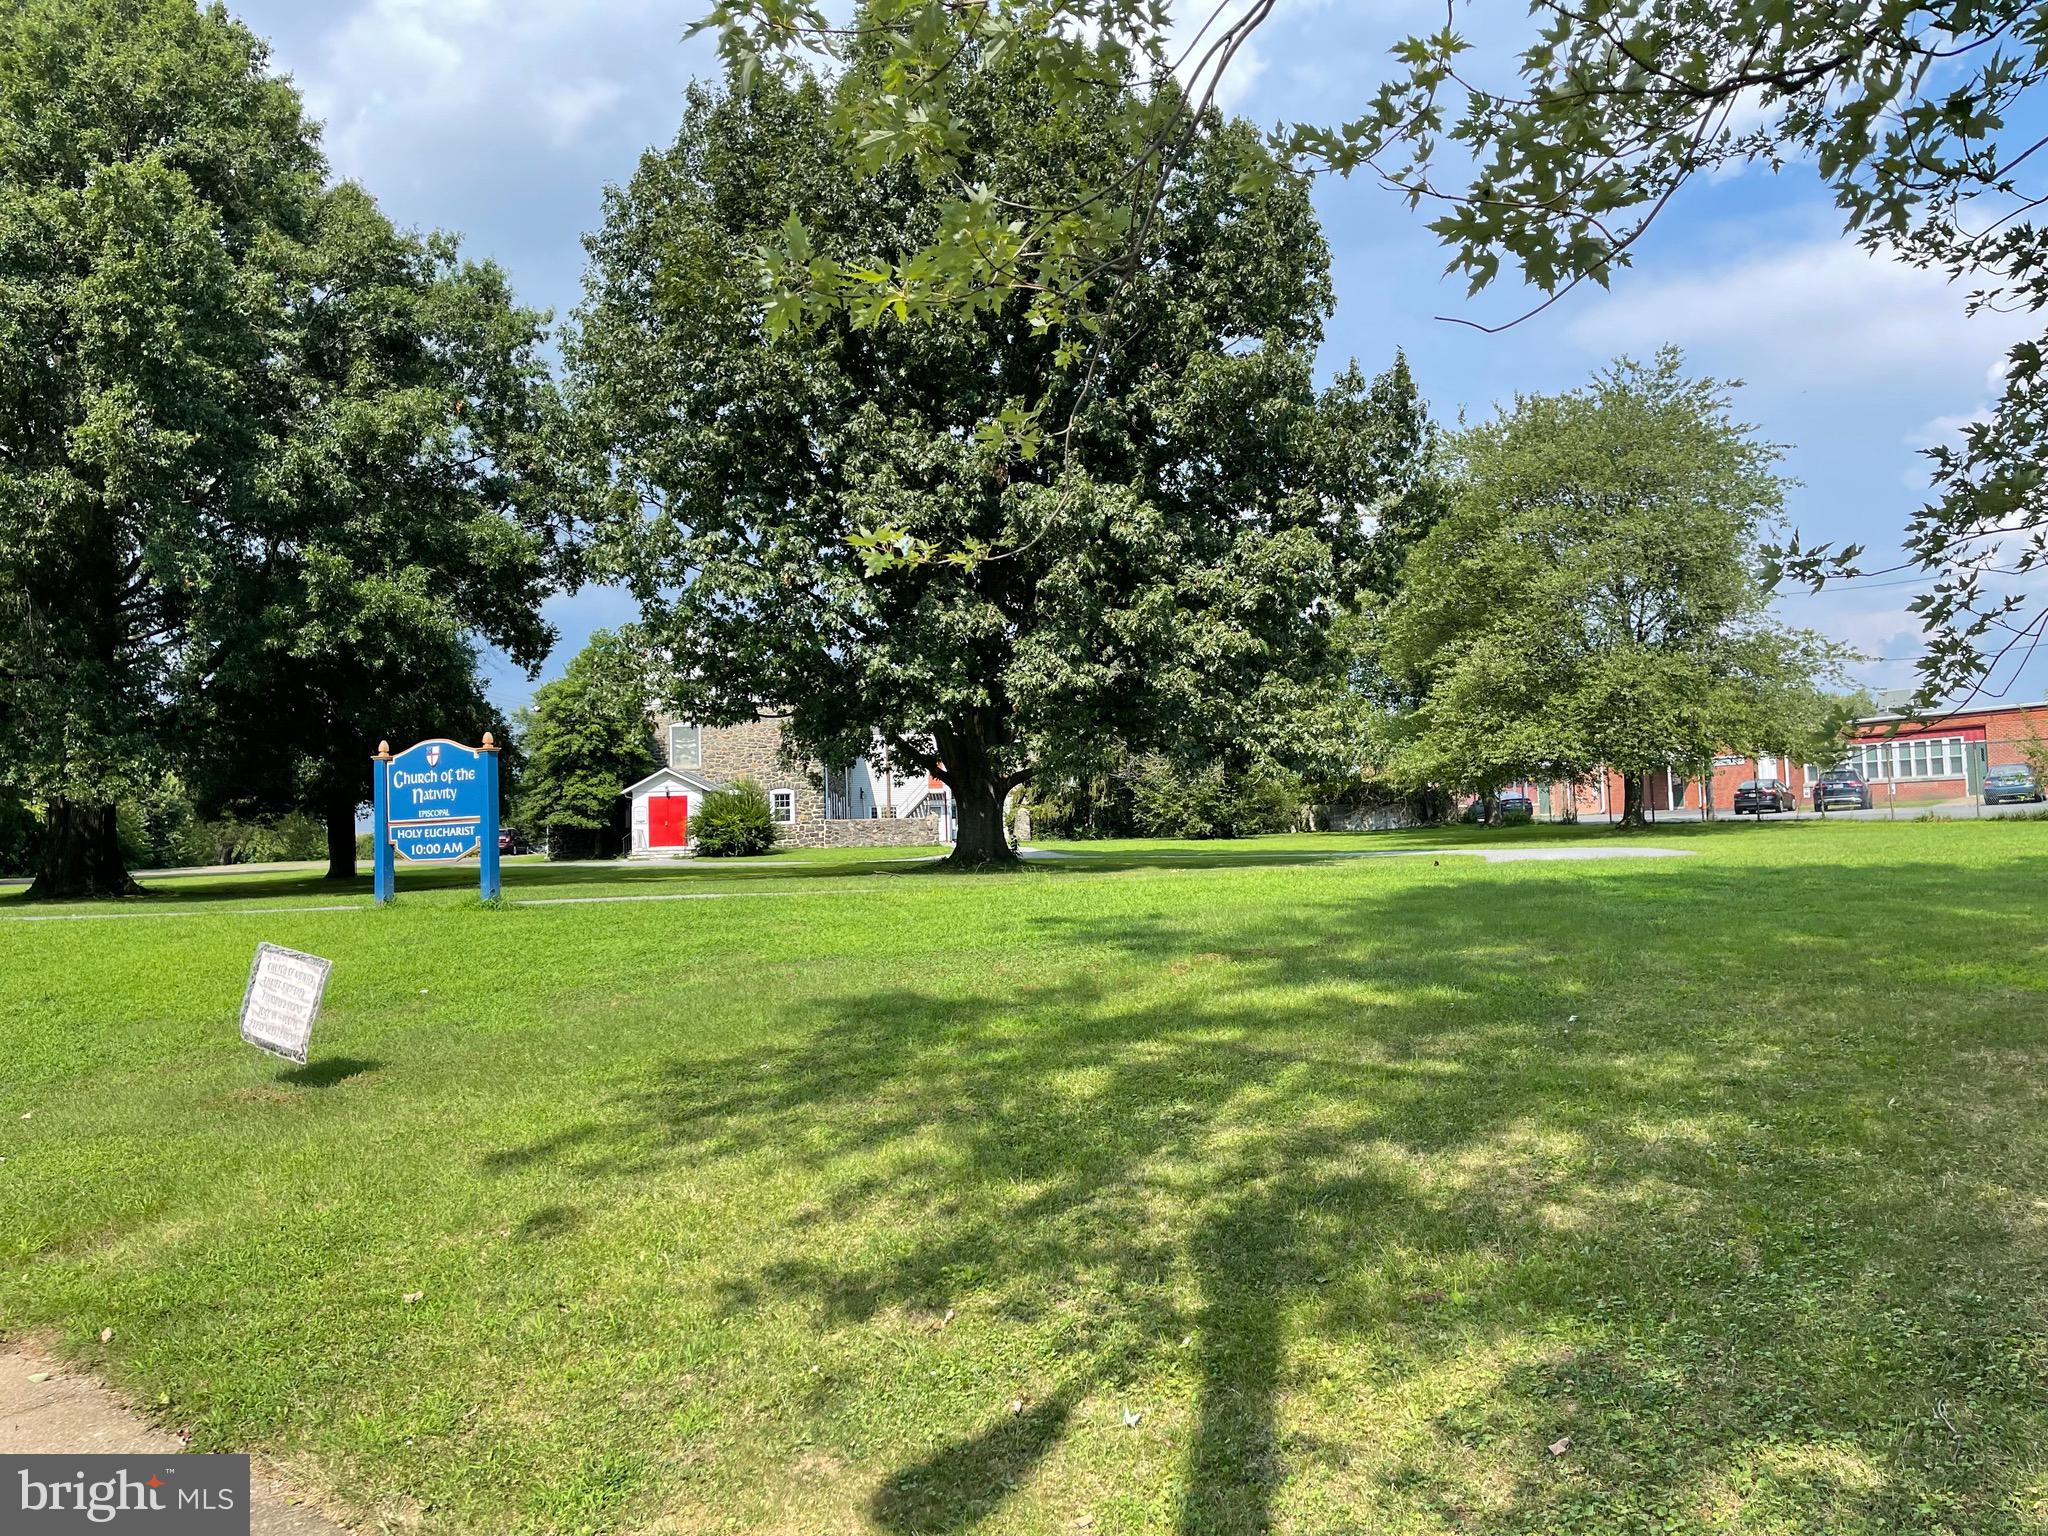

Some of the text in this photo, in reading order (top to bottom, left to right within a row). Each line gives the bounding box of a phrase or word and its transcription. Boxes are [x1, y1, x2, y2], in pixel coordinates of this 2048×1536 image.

[393, 768, 475, 788] Church of the
[412, 788, 456, 804] Nativity
[419, 809, 450, 817] EPISCOPAL
[397, 826, 475, 839] HOLY EUCHARIST
[411, 842, 463, 855] 10:00 AM
